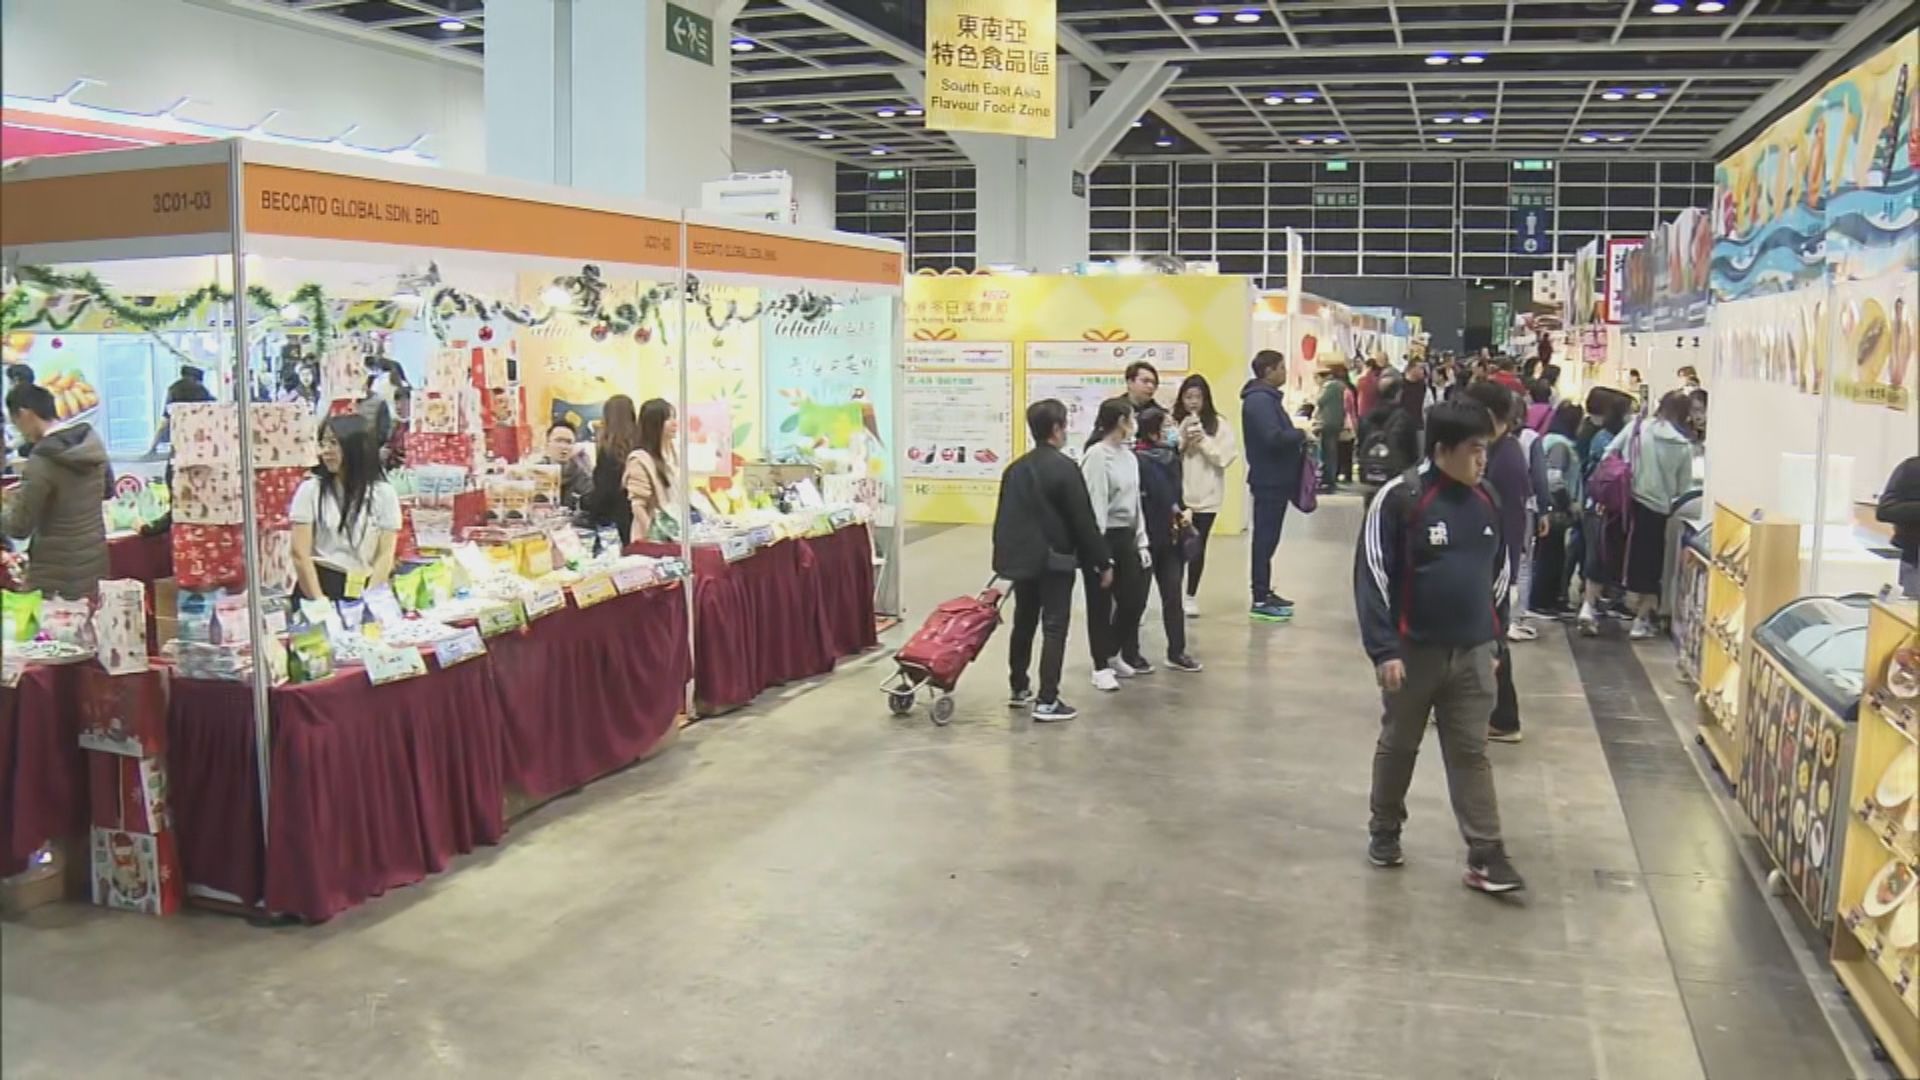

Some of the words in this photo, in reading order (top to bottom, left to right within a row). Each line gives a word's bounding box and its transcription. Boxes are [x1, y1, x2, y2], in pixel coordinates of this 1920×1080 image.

[956, 14, 1027, 43] 東南亞
[931, 40, 1050, 75] 特色食品區
[941, 78, 979, 93] South
[983, 82, 1011, 96] East
[1013, 86, 1041, 99] Asia
[931, 96, 979, 111] Flavour
[983, 100, 1015, 113] Food
[1019, 103, 1050, 117] Zone
[153, 191, 211, 213] 3C01-03
[261, 190, 327, 215] BECCATO
[330, 197, 382, 220] GLOBAL
